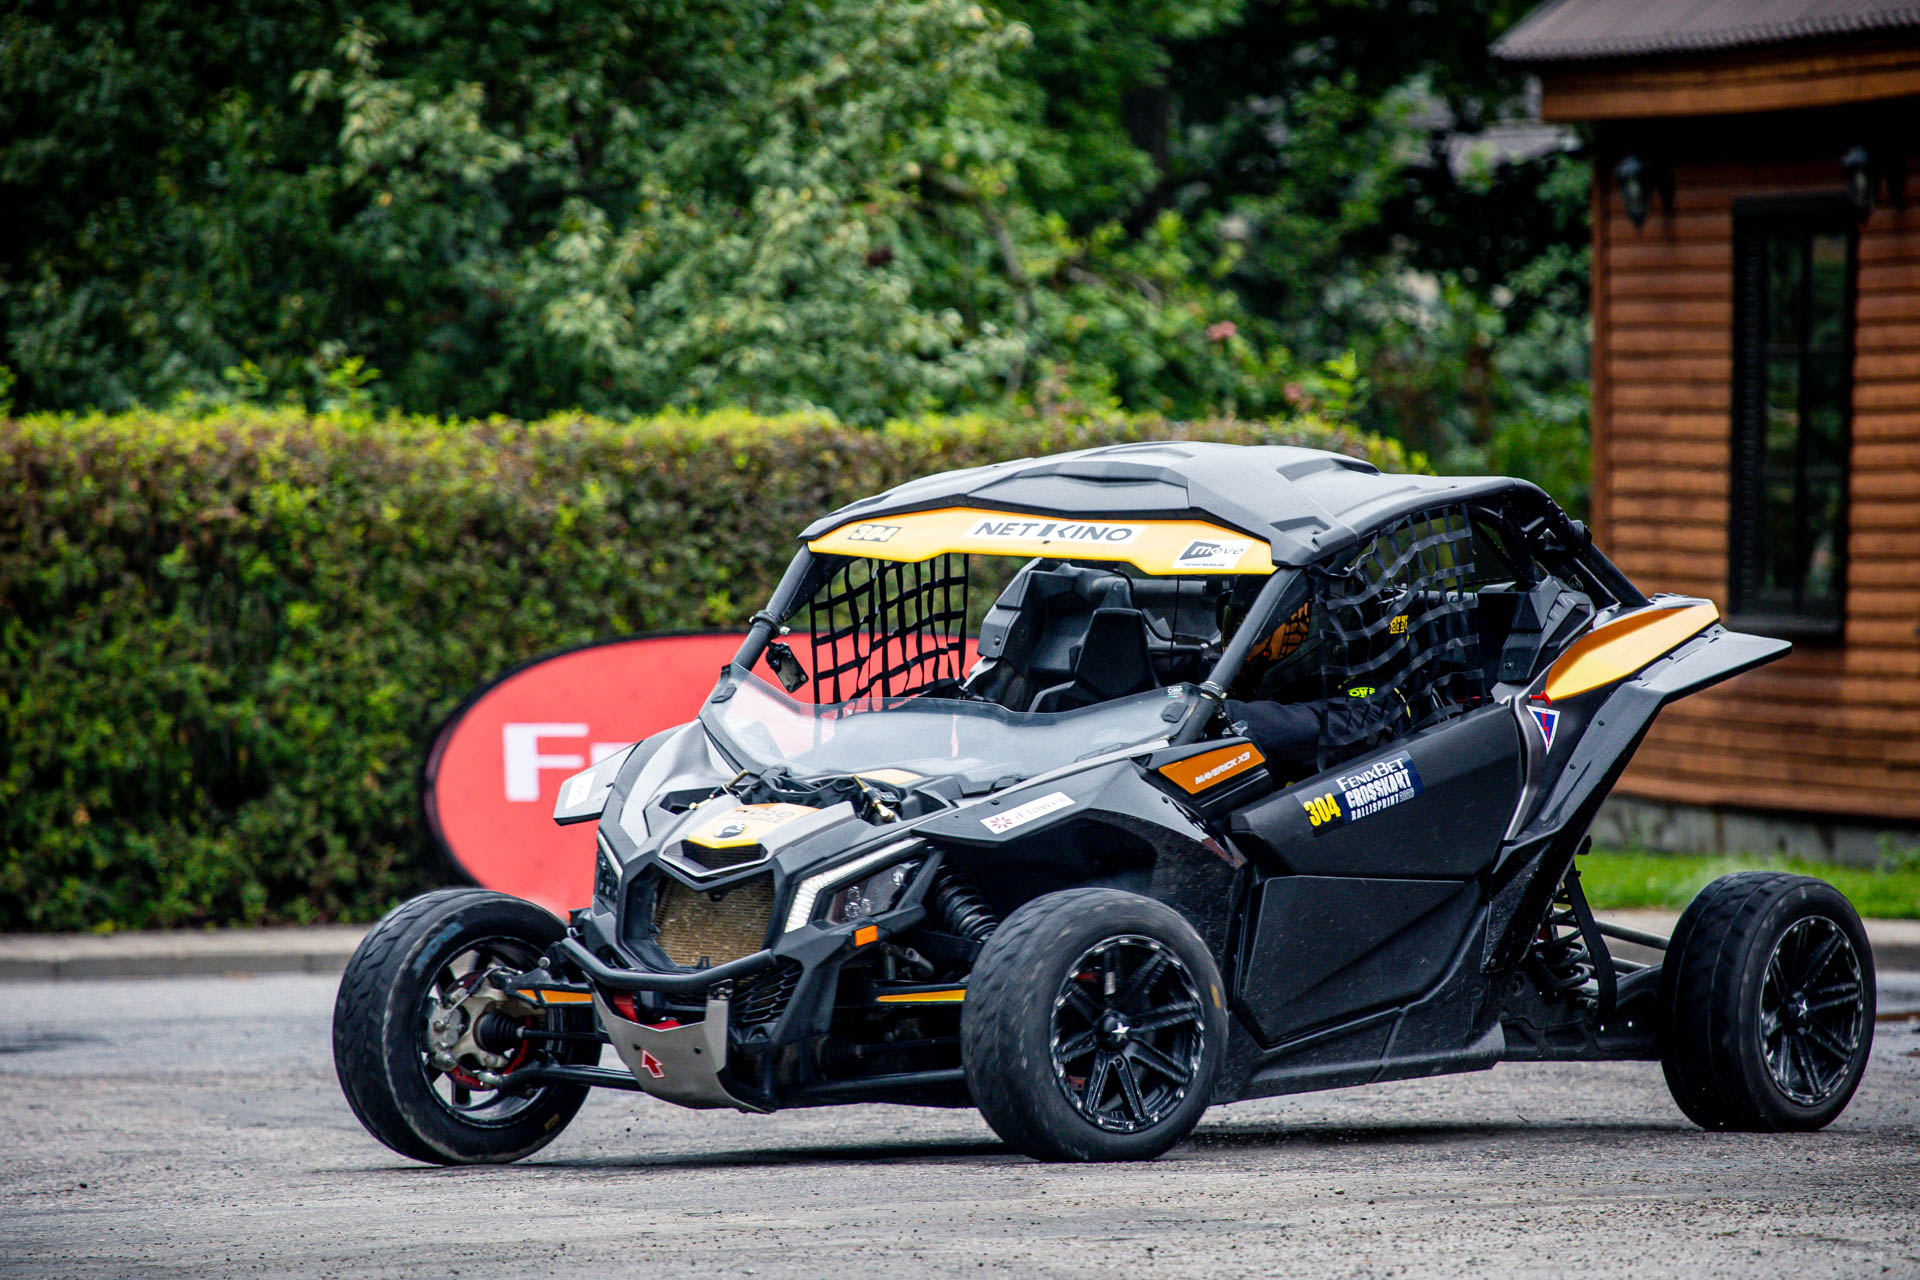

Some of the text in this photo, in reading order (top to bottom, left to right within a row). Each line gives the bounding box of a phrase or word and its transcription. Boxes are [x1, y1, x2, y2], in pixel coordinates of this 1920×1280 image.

[850, 524, 899, 542] 304
[1194, 751, 1251, 785] MAVERICK X3
[1344, 768, 1412, 809] CROSSKART
[1303, 792, 1342, 827] 304
[1350, 793, 1400, 821] RALLISPRINT
